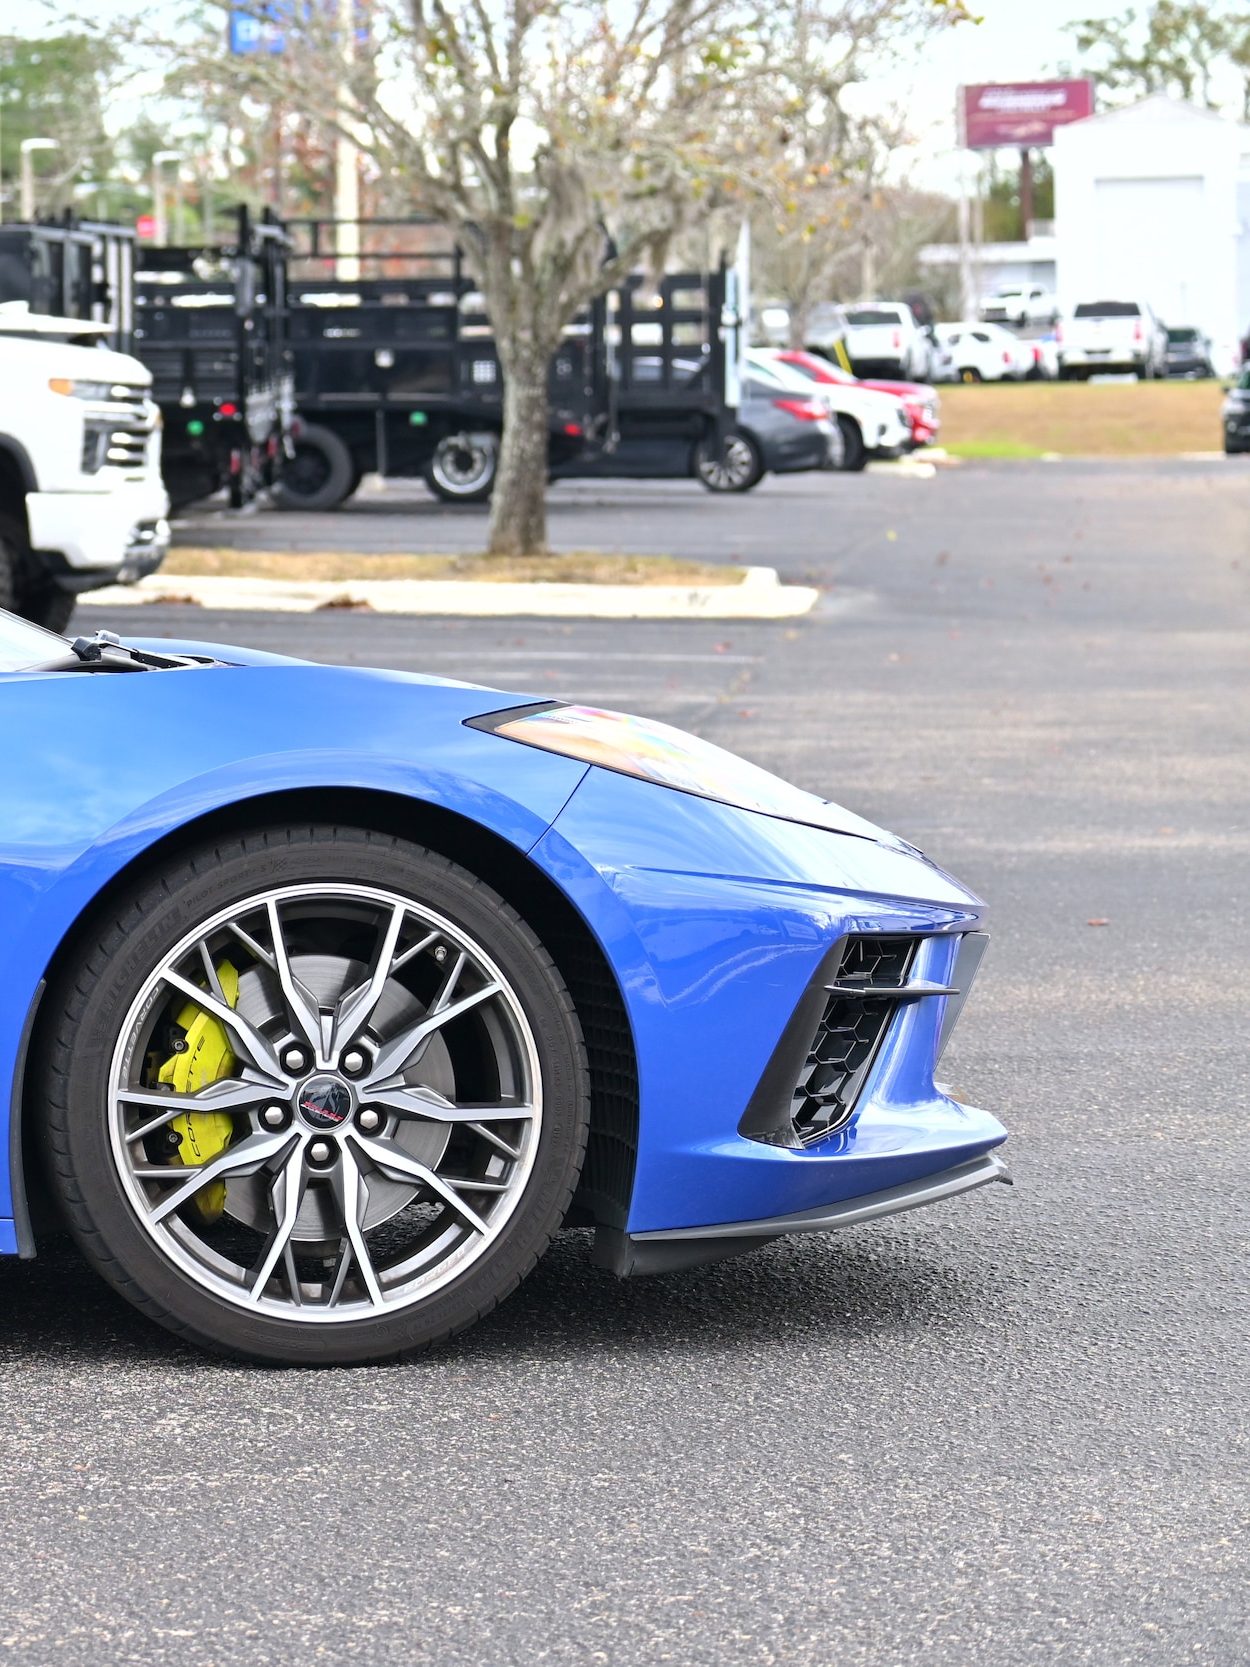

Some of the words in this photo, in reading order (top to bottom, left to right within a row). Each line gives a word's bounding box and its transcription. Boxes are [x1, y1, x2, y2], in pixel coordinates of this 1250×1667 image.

[186, 886, 215, 908] PILOT
[215, 870, 250, 889] SPORT
[100, 912, 177, 1015] MICHELIN
[121, 986, 160, 1080] CORVETTE
[403, 1247, 466, 1293] FORGED
[474, 1189, 553, 1292] MICHELIN
